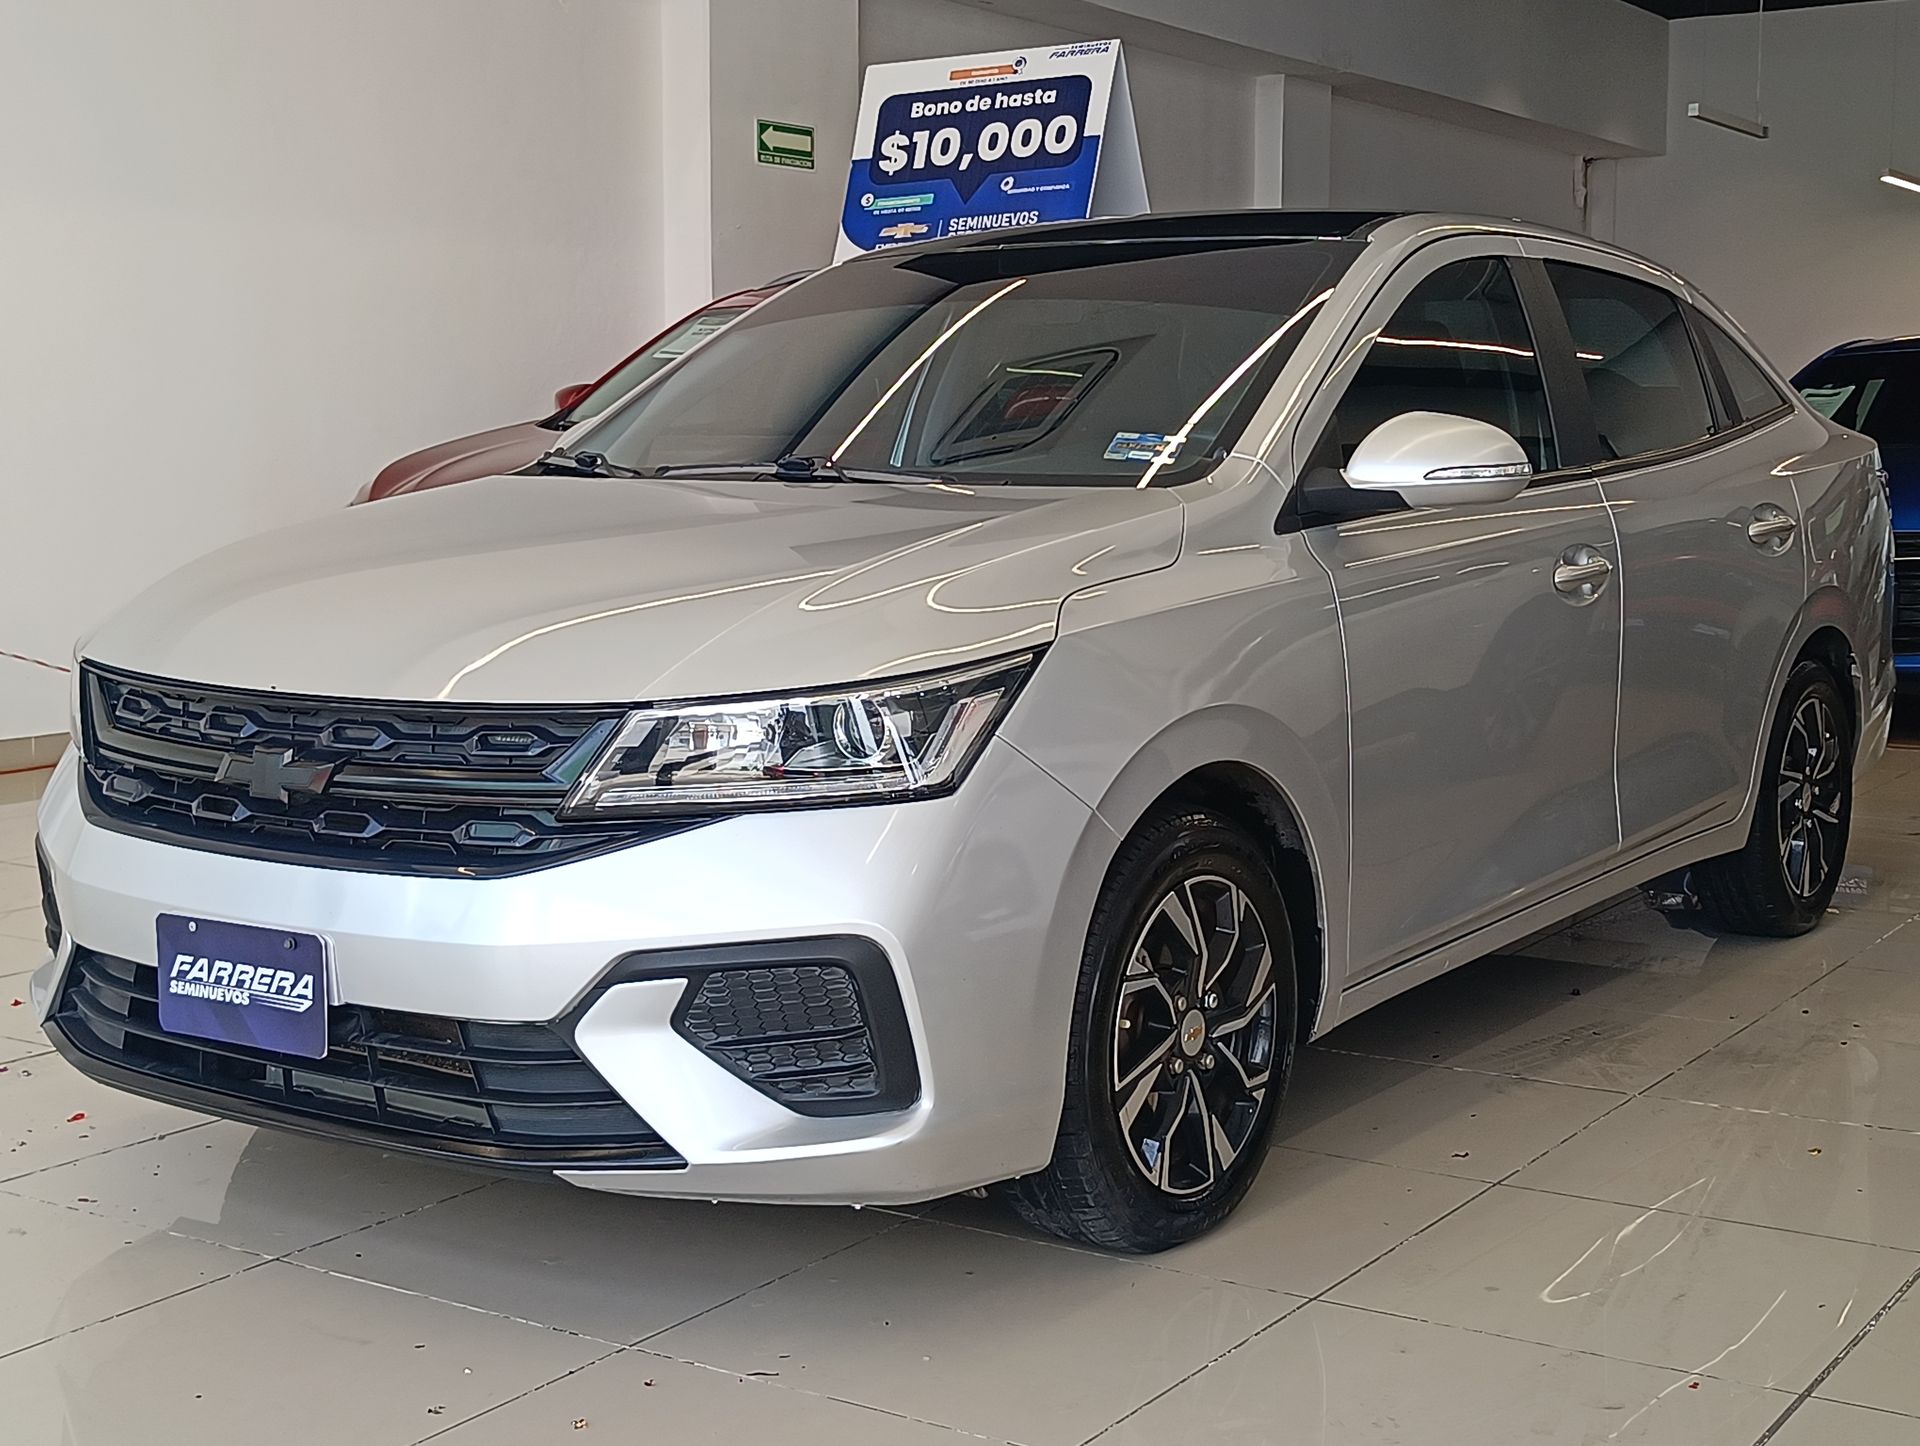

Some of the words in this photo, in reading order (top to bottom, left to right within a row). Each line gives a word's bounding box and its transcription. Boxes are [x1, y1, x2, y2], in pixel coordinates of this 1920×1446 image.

[1049, 46, 1110, 59] FARRERA
[910, 101, 963, 119] Bono
[965, 94, 992, 113] de
[994, 88, 1058, 110] hasta
[878, 114, 1078, 177] $10,000
[948, 210, 1039, 232] SEMINUEVOS
[170, 954, 314, 1000] FARRERA
[169, 979, 250, 1006] SEMINUEVOS
